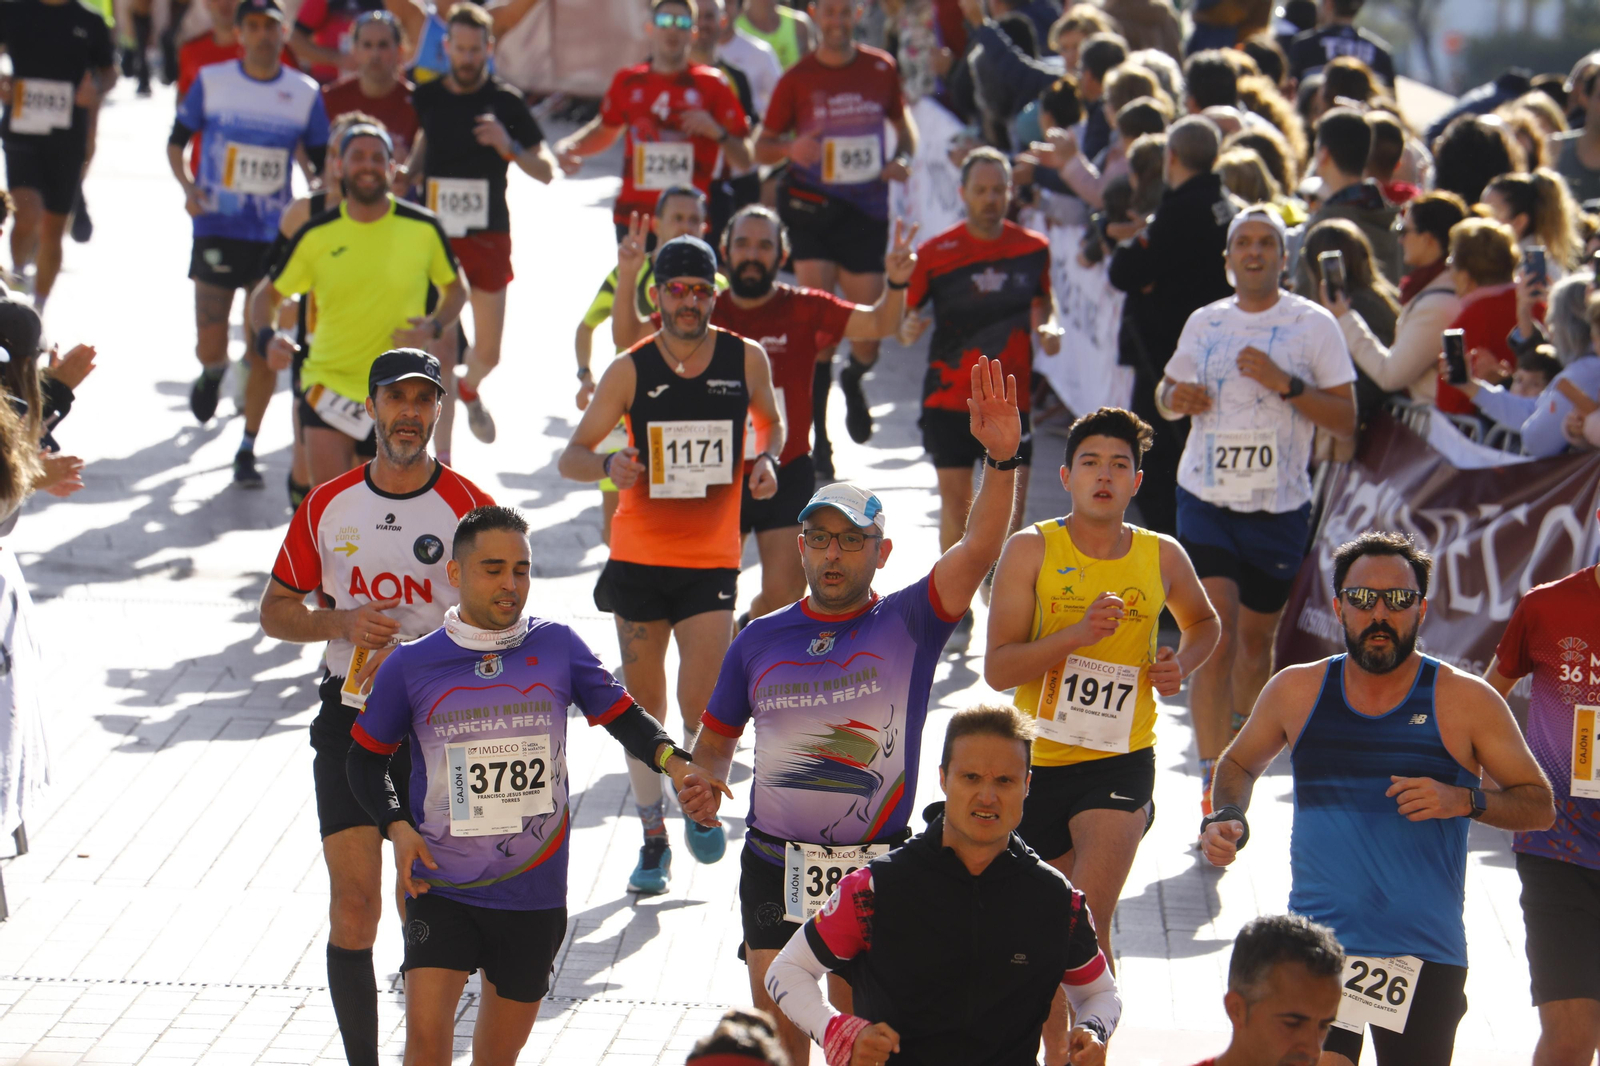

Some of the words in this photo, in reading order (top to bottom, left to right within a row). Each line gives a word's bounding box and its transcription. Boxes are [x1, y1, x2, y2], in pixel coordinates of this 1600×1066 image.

[666, 439, 724, 464] 1171
[1215, 445, 1273, 469] 2770
[376, 524, 402, 532] VIATOR
[349, 566, 433, 604] AON
[1078, 659, 1115, 674] IMDECO
[1559, 664, 1583, 682] 36
[756, 682, 809, 699] ATLETISMO
[814, 682, 820, 692] Y
[823, 666, 878, 691] MONTAÑA
[1045, 677, 1057, 705] CAJÓN
[1064, 673, 1134, 712] 1917
[758, 694, 828, 712] MANCHA
[832, 681, 881, 703] REAL
[432, 706, 490, 725] ATLETISMO
[493, 706, 500, 716] Y
[503, 701, 552, 715] MONTAÑA
[434, 719, 508, 737] MANCHA
[512, 715, 552, 728] REAL
[479, 743, 519, 754] IMDECO
[1579, 738, 1588, 764] CAJÓN
[453, 774, 465, 804] CAJÓN
[469, 758, 546, 794] 3782
[818, 851, 856, 859] IMDECO
[791, 874, 800, 904] CAJÓN
[806, 866, 859, 897] 38
[1344, 960, 1409, 1006] 226
[1348, 993, 1373, 1007] ACEITUNO
[1373, 1003, 1398, 1014] CANTERO
